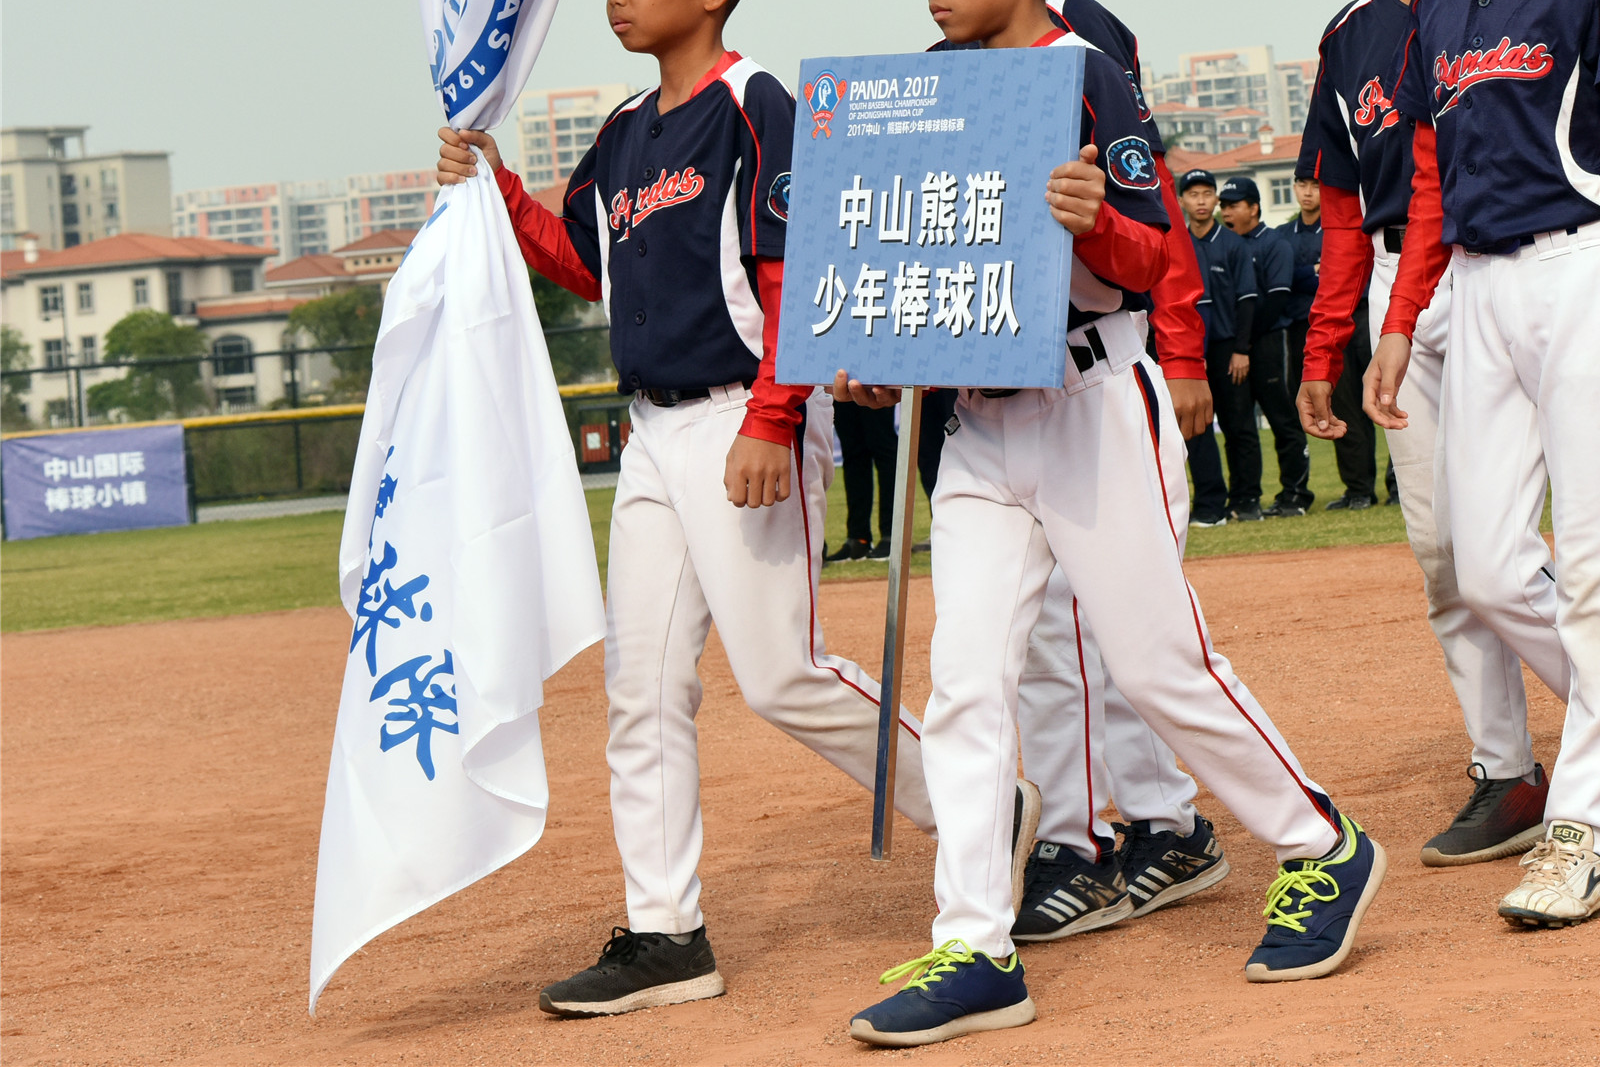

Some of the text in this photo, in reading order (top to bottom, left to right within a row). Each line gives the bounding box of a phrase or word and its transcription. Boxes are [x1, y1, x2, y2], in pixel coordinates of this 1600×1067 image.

[849, 75, 940, 101] PANDA 2017
[1433, 36, 1555, 114] Pandas
[848, 97, 938, 111] YOUTH BASEBALL CHAMPIONSHIP
[848, 108, 924, 120] OF ZHONGSHAN PANDA CUP
[838, 170, 1007, 250] 中山熊猫
[811, 260, 1021, 338] 少年棒球队
[43, 450, 146, 483] 中山国际
[1552, 826, 1584, 841] ZETT
